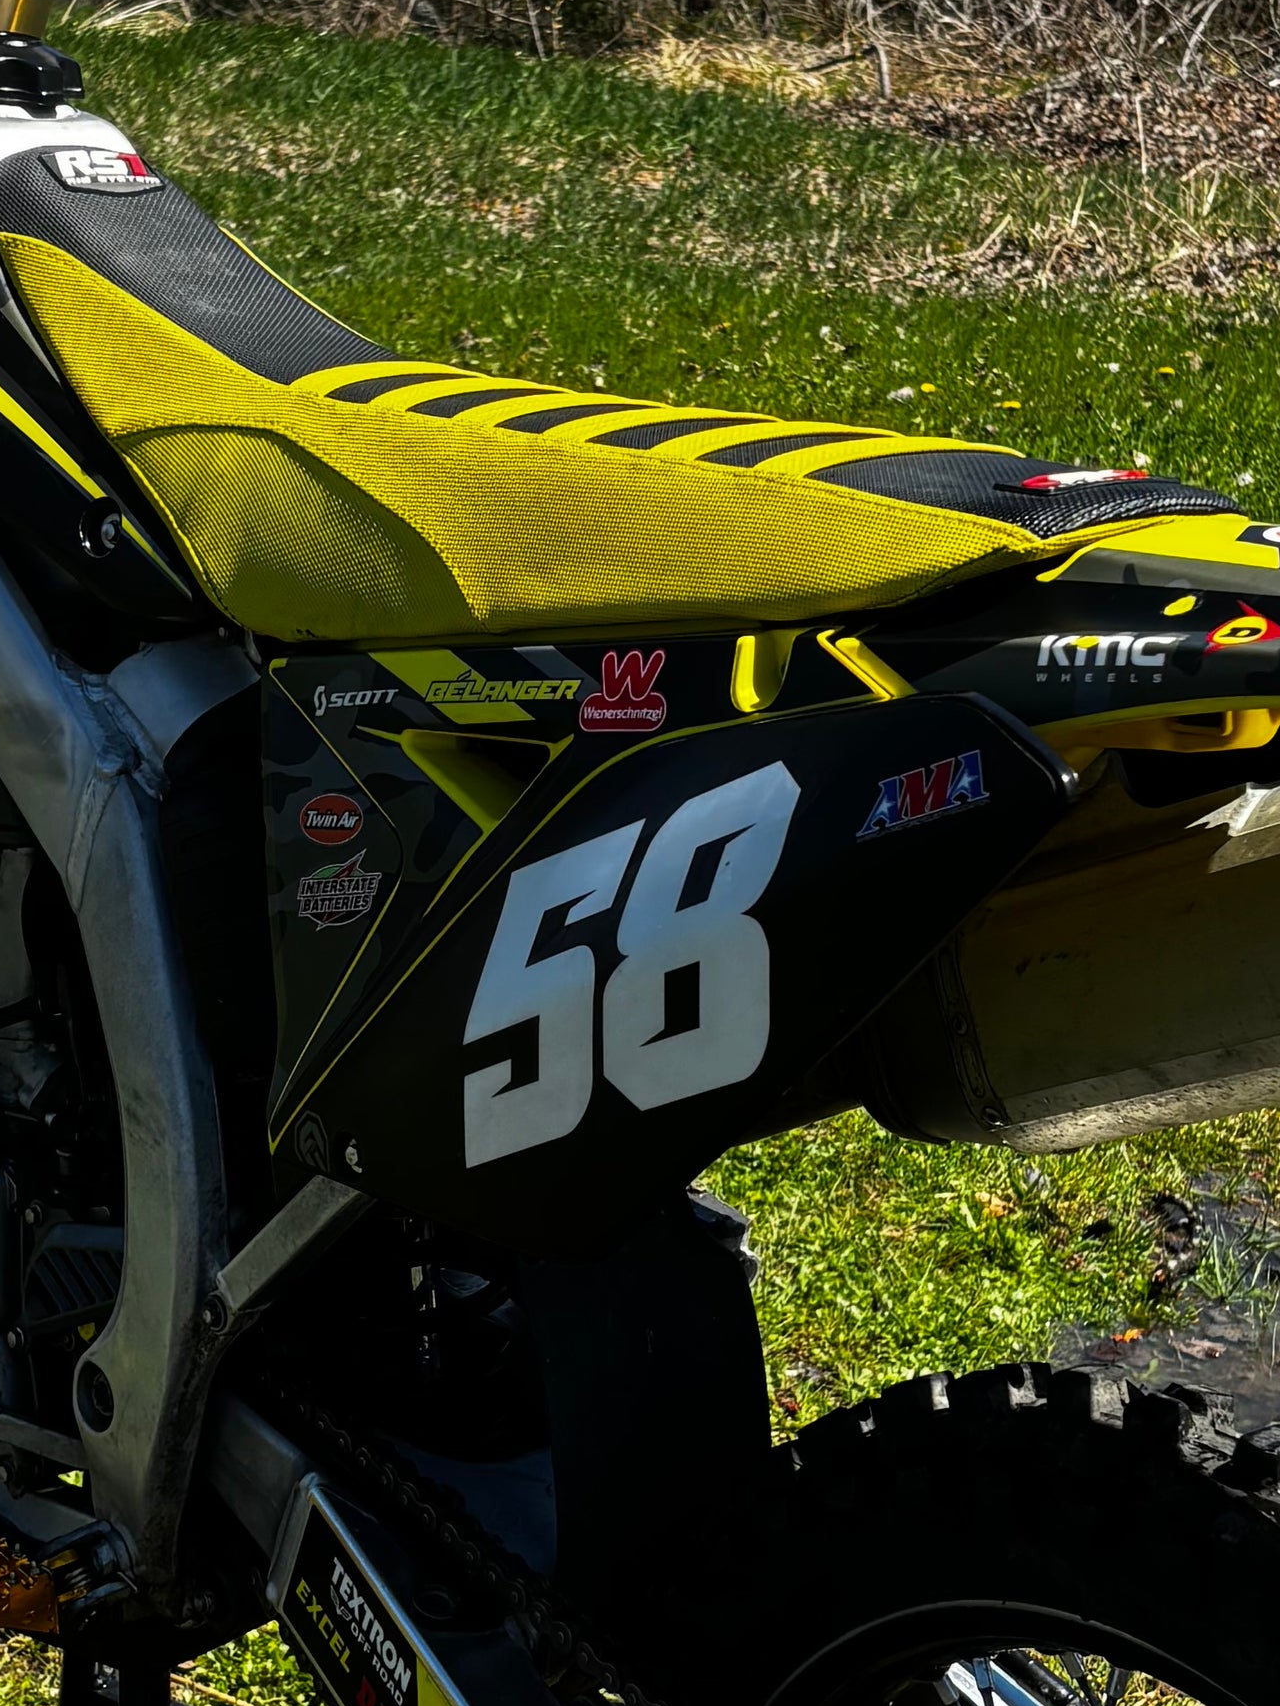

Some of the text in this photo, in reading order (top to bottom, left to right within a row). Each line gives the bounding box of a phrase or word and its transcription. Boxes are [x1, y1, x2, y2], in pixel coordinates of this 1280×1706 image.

[1035, 672, 1163, 683] WHEELS
[328, 689, 399, 708] SCOTT
[583, 706, 663, 722] Wienerschnitzel
[856, 749, 990, 838] AMA
[306, 810, 360, 829] Twin Air
[299, 876, 378, 896] INTERSTATE
[301, 895, 371, 914] BATTERIES
[463, 760, 801, 1168] 58
[296, 1577, 350, 1673] EXCEL
[332, 1556, 411, 1693] TEXTRON
[350, 1621, 403, 1706] OFF ROAD
